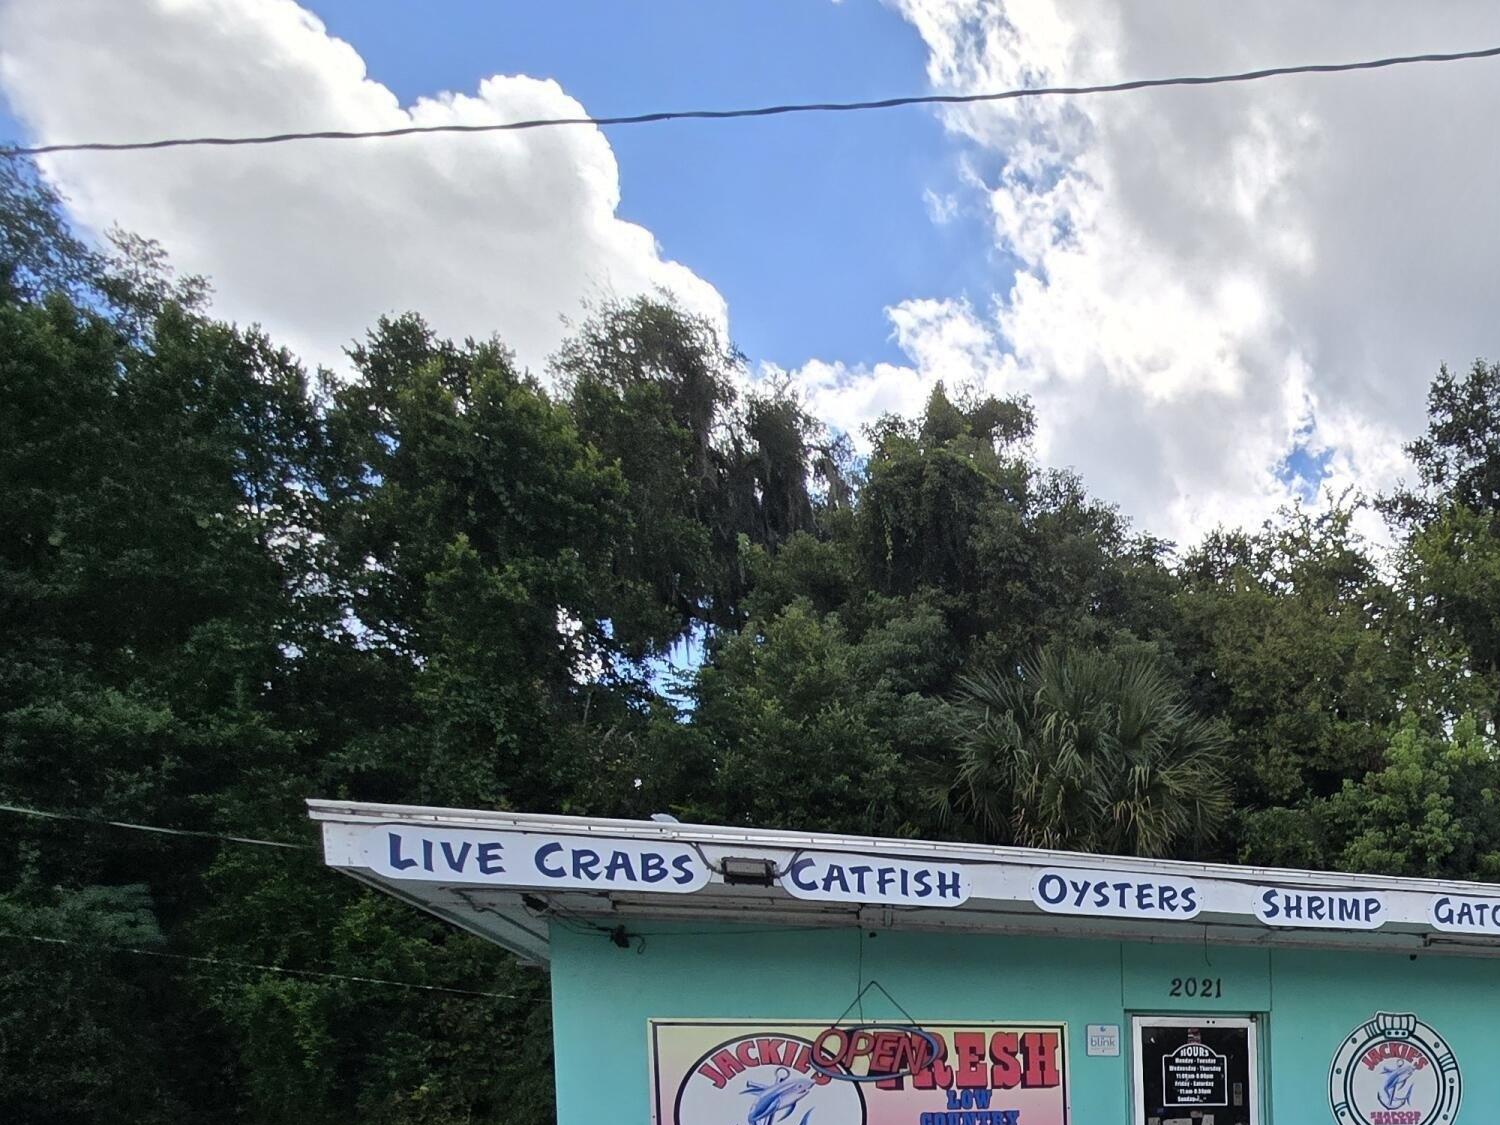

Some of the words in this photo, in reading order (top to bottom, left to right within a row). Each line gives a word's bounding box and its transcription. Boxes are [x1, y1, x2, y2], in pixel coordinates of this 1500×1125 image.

[388, 832, 505, 875] LIVE
[534, 842, 694, 885] CRABS
[790, 857, 961, 898] CATFISH
[1038, 873, 1197, 912] OYSTERS
[1262, 889, 1382, 923] SHRIMP
[1169, 977, 1221, 998] 2021
[812, 1028, 929, 1075] OPEN
[1090, 1036, 1115, 1047] blink
[1180, 1046, 1209, 1057] HOURS
[1361, 1042, 1429, 1071] JACKIE'S
[945, 1088, 993, 1110] LOW
